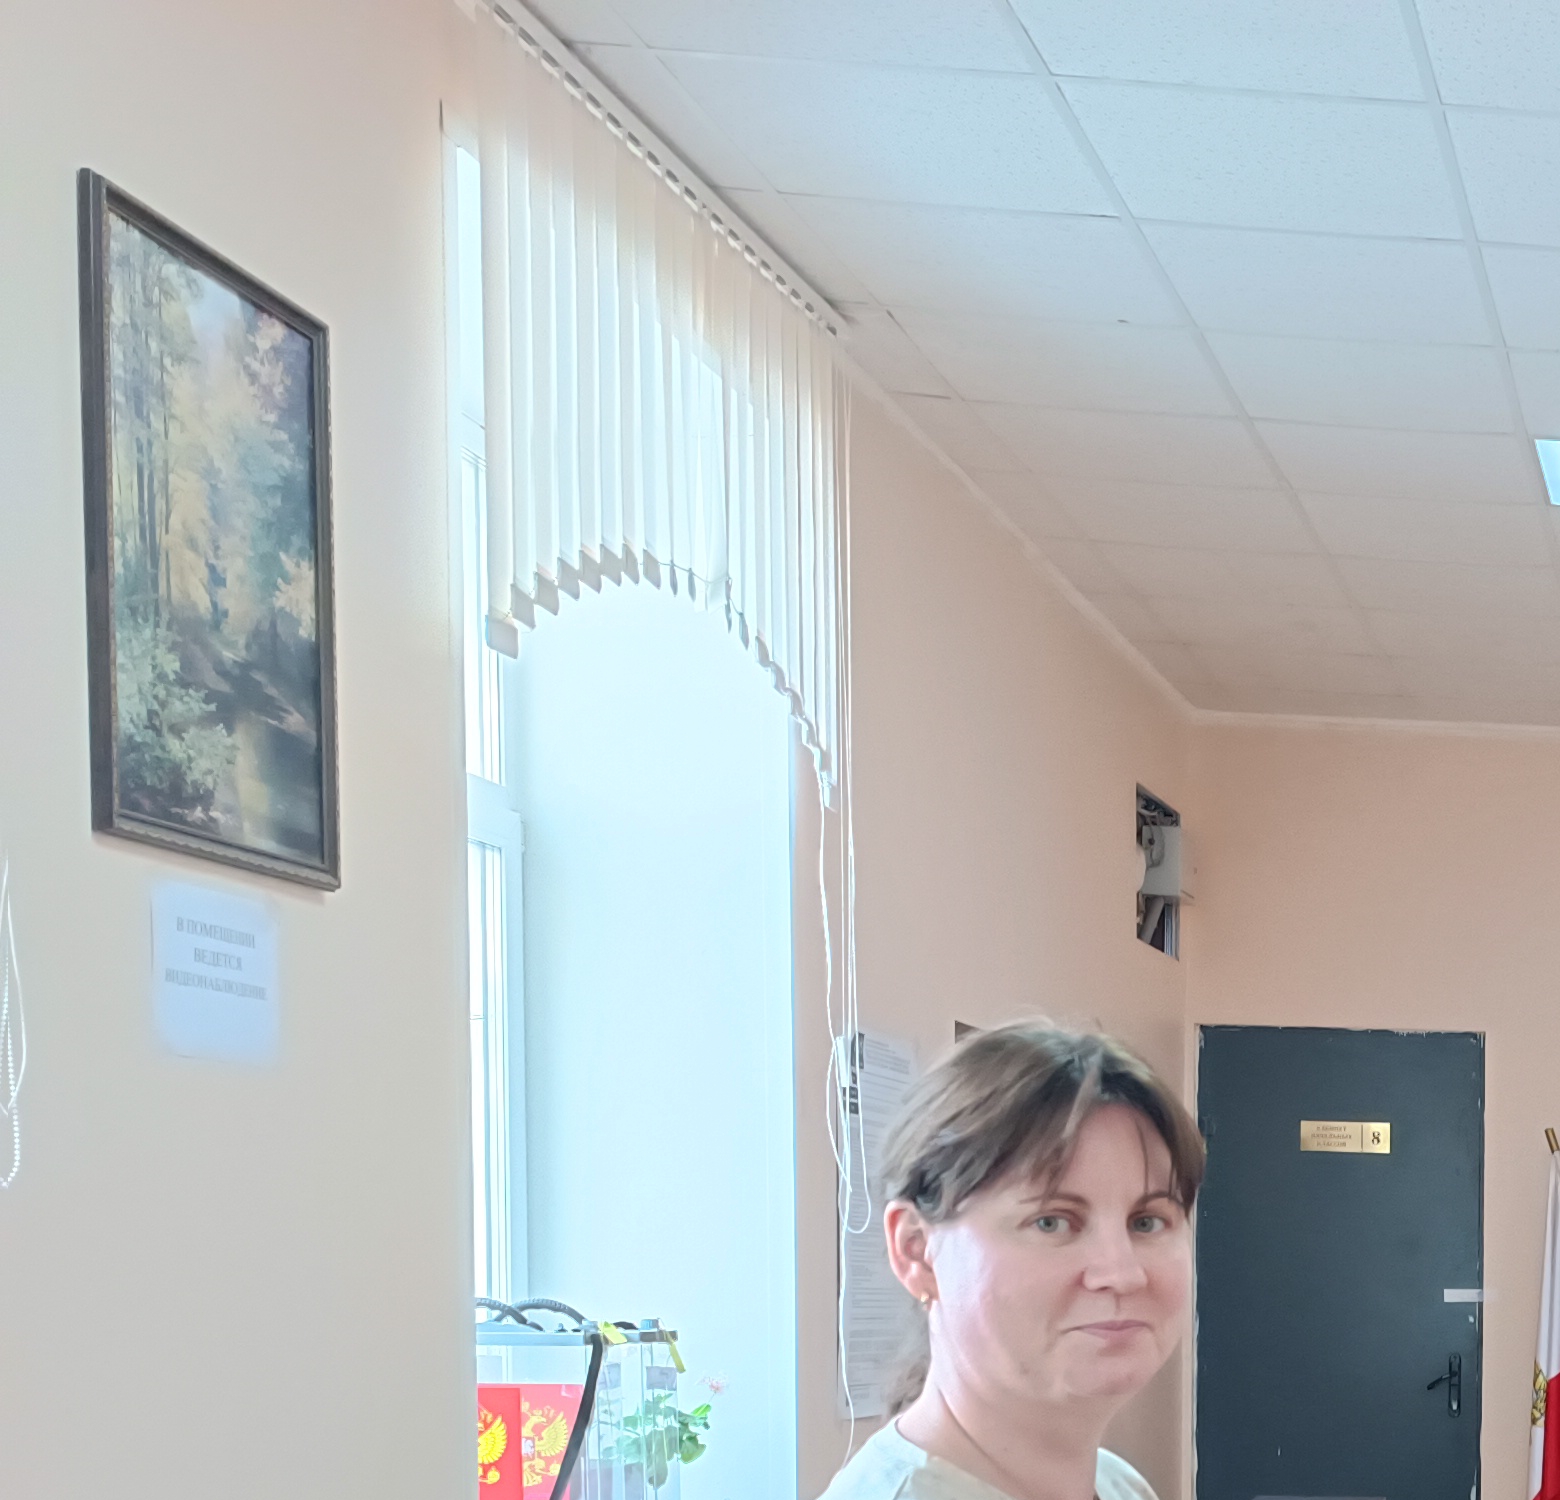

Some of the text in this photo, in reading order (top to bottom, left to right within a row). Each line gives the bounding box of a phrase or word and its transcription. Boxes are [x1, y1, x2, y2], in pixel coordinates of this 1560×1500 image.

[176, 917, 184, 932] В
[193, 947, 243, 971] ВЕДЕТСЯ
[1371, 1131, 1381, 1146] 8
